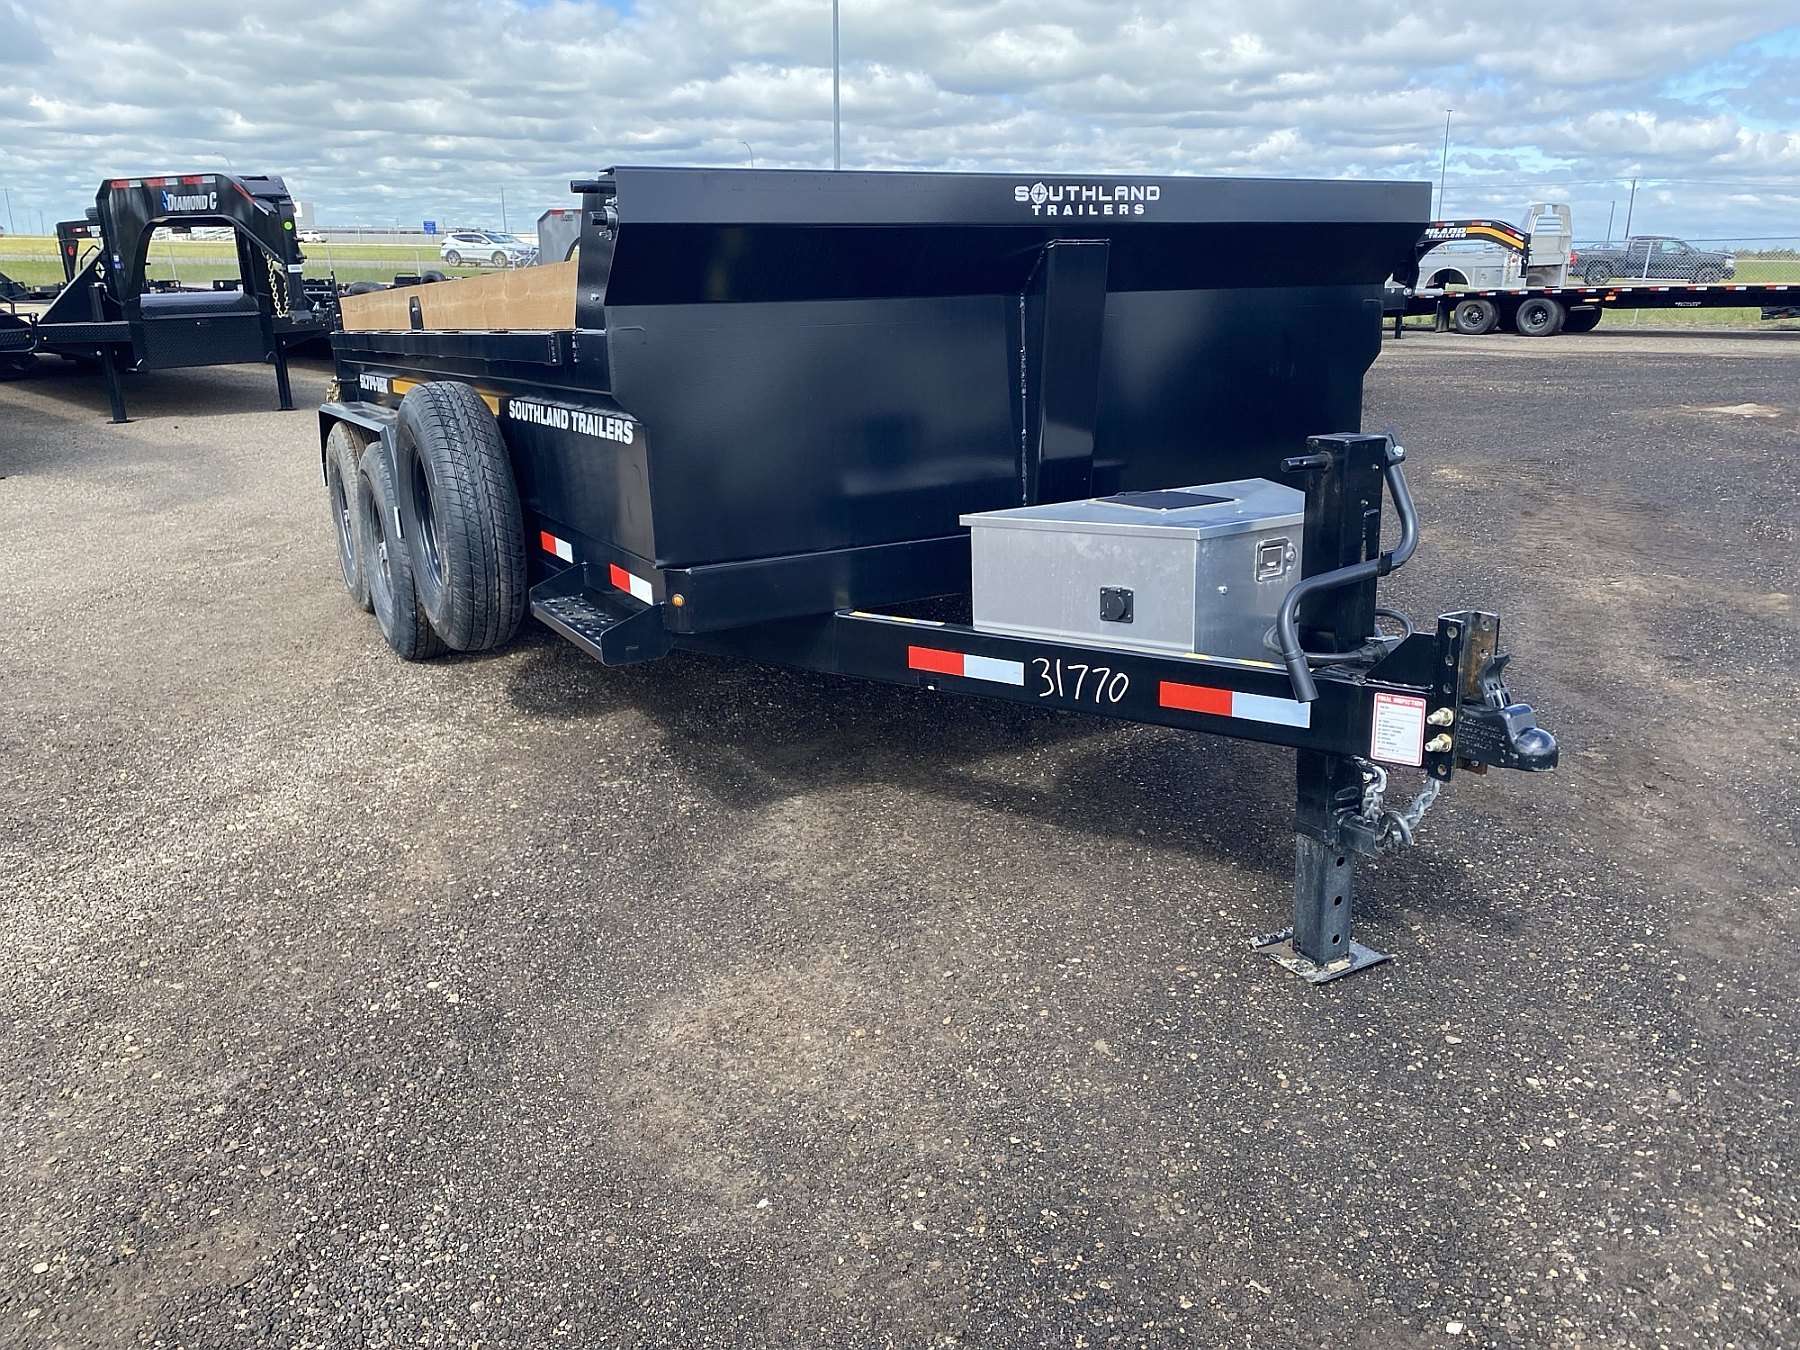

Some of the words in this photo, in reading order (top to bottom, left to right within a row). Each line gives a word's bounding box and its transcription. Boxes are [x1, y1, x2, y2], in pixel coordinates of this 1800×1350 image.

[167, 194, 208, 211] DIAMOND
[209, 191, 217, 210] C
[1014, 182, 1161, 204] SOUTHLAND
[1031, 204, 1145, 216] TRAILERS
[508, 399, 569, 431] SOUTHLAND
[570, 411, 634, 445] TRAILERS
[1031, 657, 1130, 704] 31770
